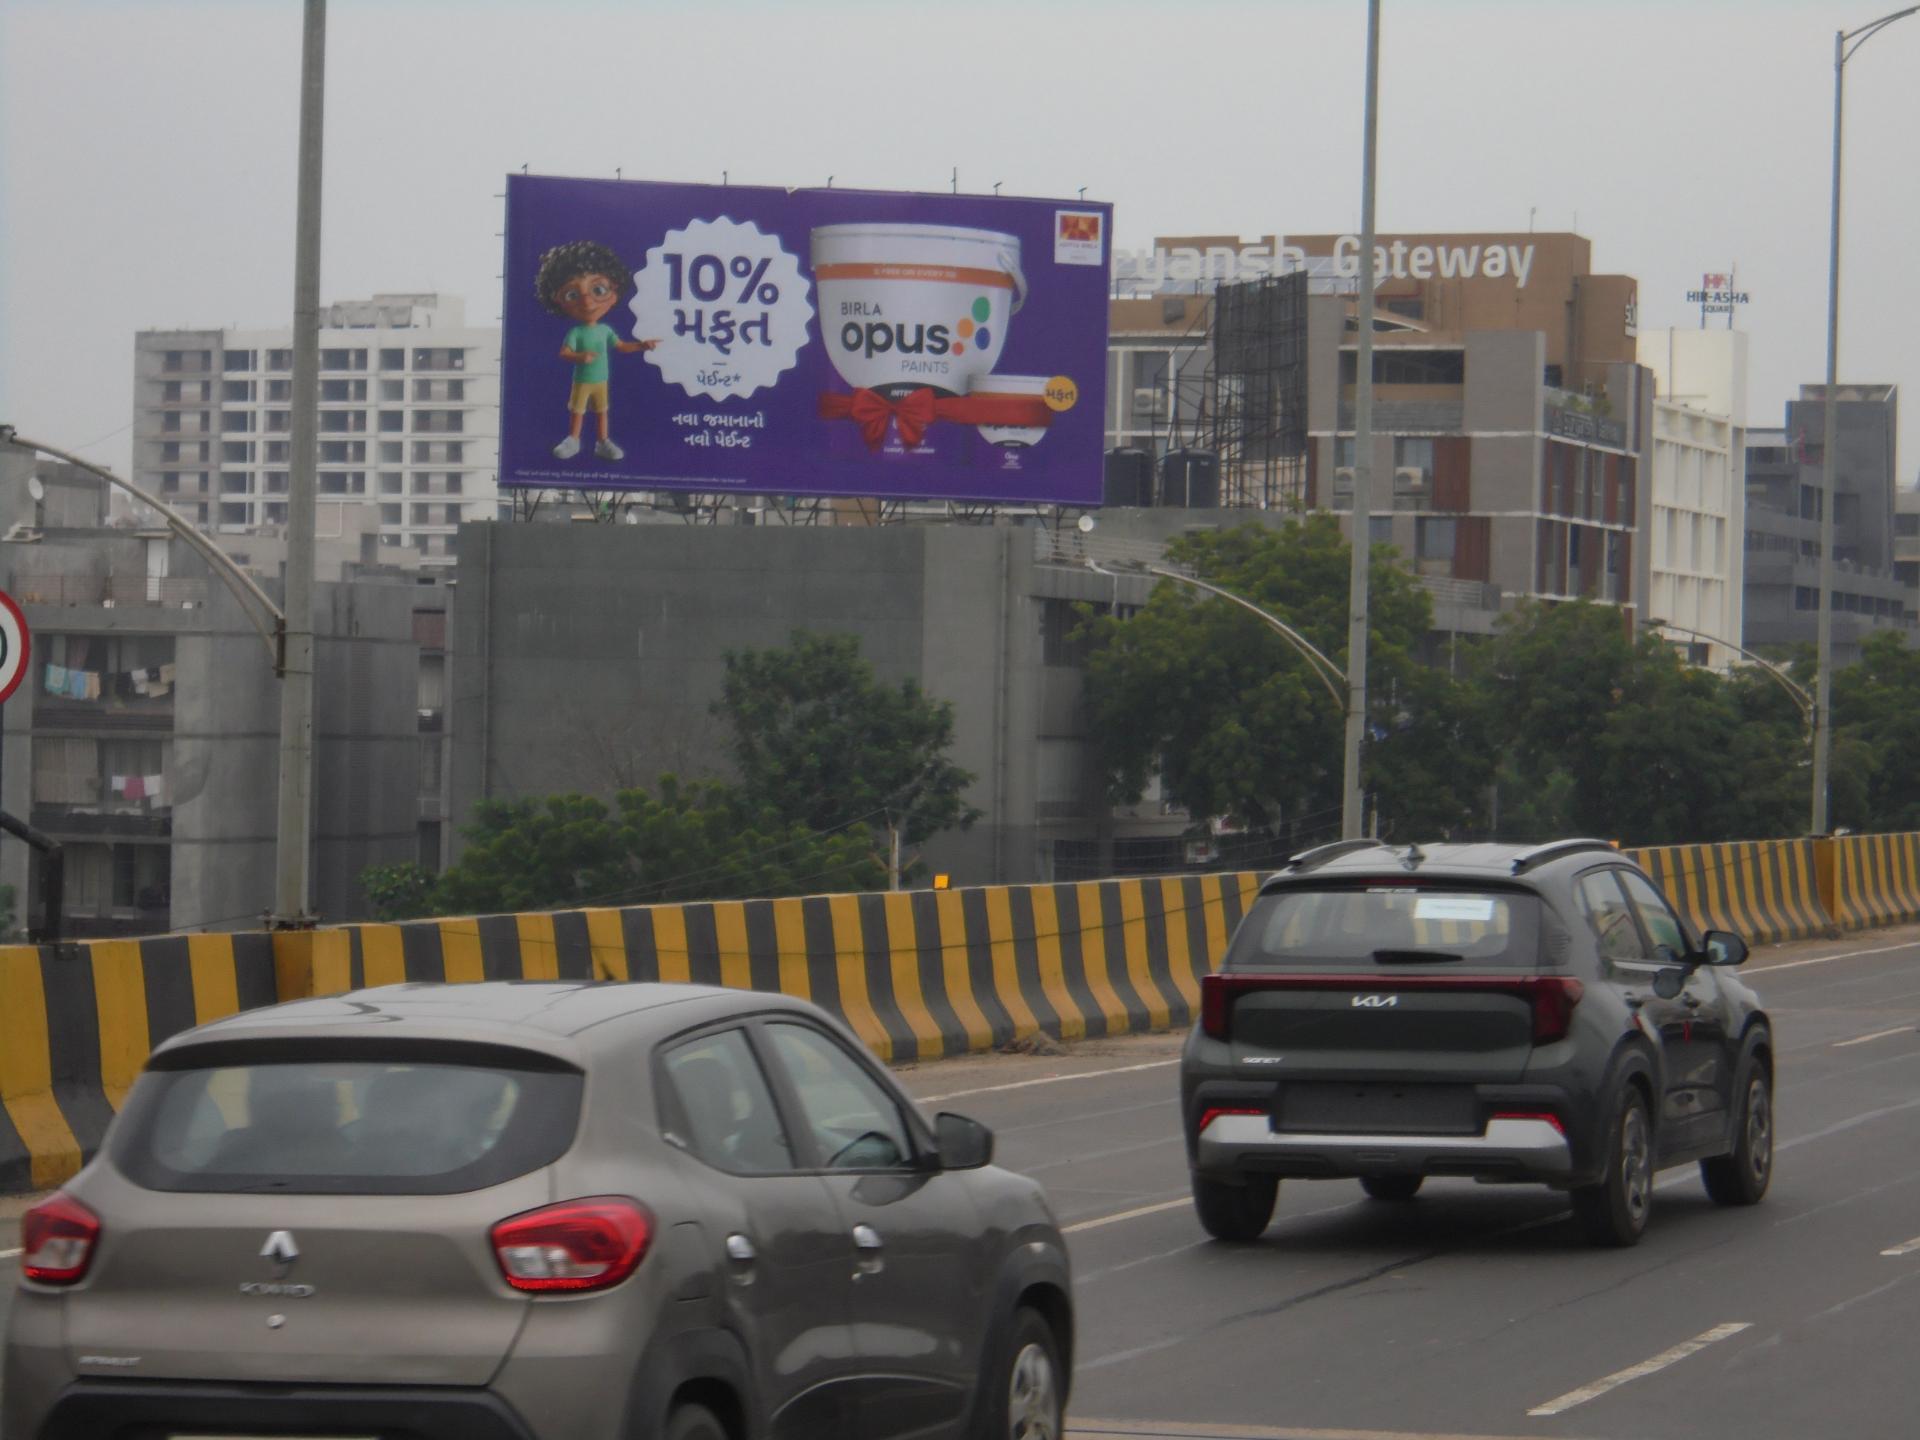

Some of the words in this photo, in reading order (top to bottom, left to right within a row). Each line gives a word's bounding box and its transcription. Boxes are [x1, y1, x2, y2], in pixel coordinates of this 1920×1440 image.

[662, 253, 779, 305] 10%
[841, 302, 882, 316] BIRLA
[673, 309, 772, 355] મફત
[841, 321, 949, 358] opus
[901, 360, 949, 374] PAINTS
[672, 413, 698, 426] નવા
[684, 430, 710, 447] નવો
[1351, 995, 1398, 1008] KIA
